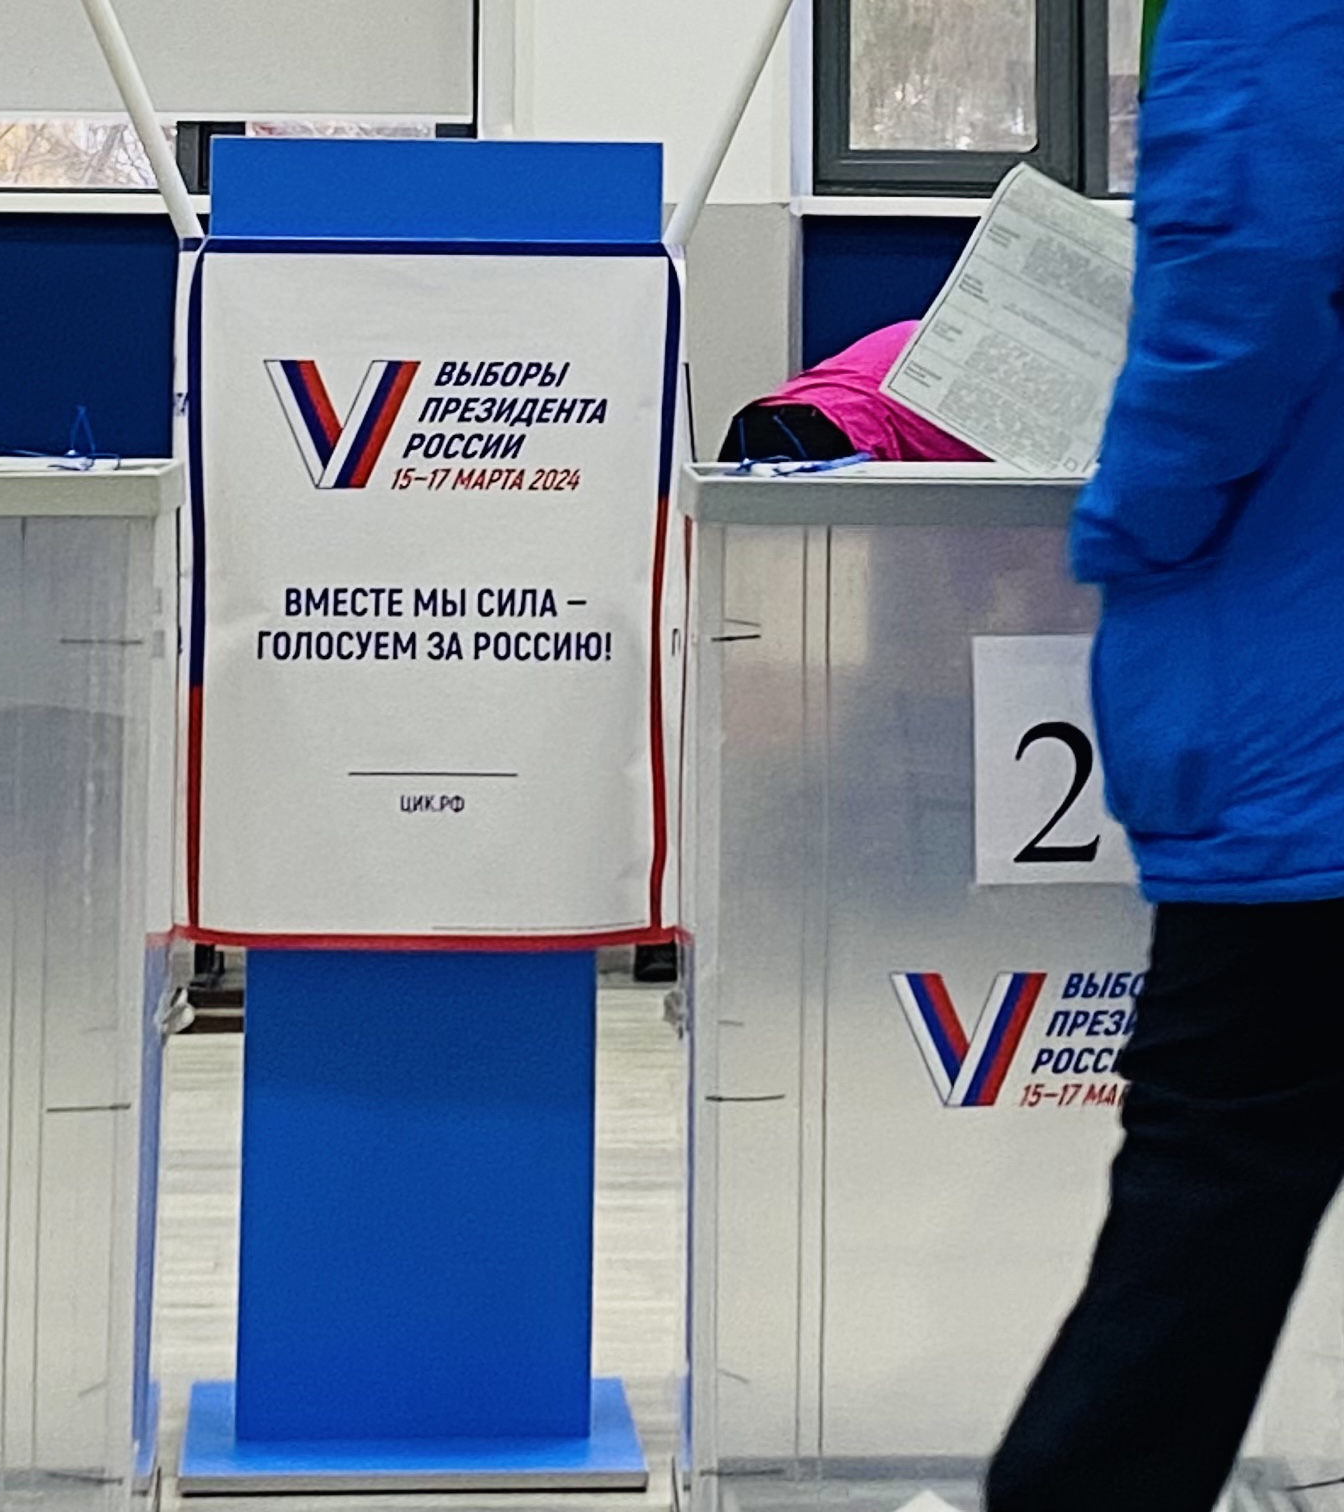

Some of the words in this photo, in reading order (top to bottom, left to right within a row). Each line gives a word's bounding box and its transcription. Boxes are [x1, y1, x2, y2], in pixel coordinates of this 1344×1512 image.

[434, 360, 570, 388] ВЫБОРЫ
[418, 397, 607, 427] ПРЕЗИДЕНТА
[402, 432, 526, 460] РОССИИ
[451, 468, 524, 491] МАРТА
[528, 468, 581, 491] 2024
[284, 587, 404, 618] ВМЕСТЕ
[414, 587, 467, 618] МЫ
[477, 587, 558, 618] СИЛА
[257, 631, 417, 661] ГОЛОСУЕМ
[427, 631, 463, 661] ЗА
[474, 631, 612, 661] РОССИЮ!
[400, 795, 464, 814] ЦИК.РФ
[1014, 721, 1100, 863] 2
[1082, 1083, 1124, 1108] МА
